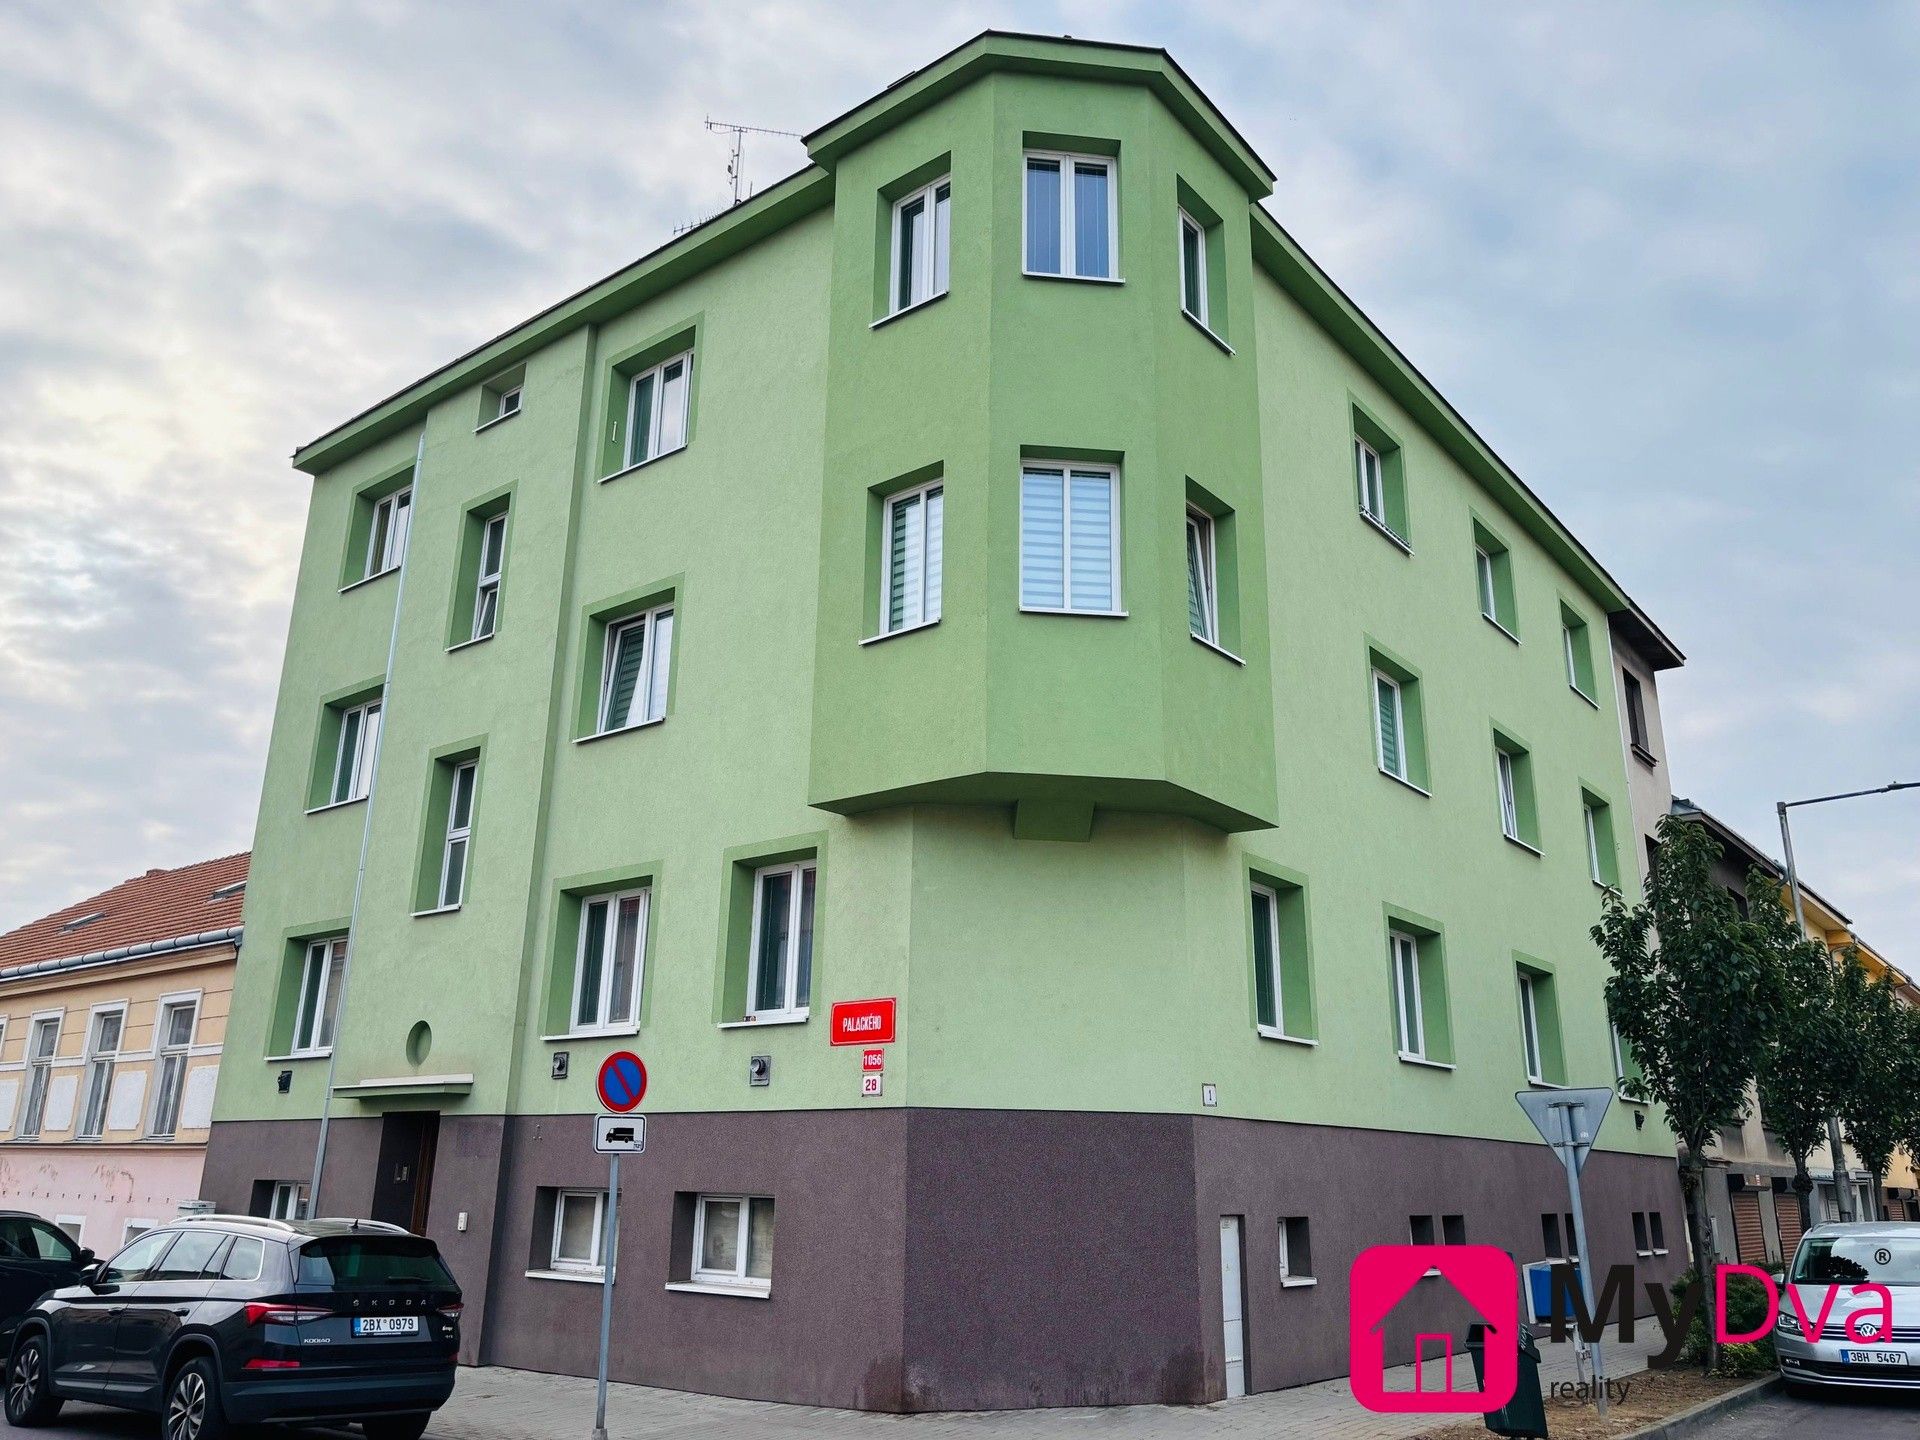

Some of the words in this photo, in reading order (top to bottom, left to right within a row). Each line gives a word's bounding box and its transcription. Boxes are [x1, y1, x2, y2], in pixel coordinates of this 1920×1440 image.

[842, 1013, 882, 1032] PALACKÉHO
[863, 1054, 882, 1066] 1056
[865, 1078, 877, 1091] 28
[362, 1318, 382, 1331] 2BX
[389, 1318, 414, 1330] 0979
[1850, 1352, 1870, 1362] 3BH
[1876, 1353, 1901, 1364] 5467
